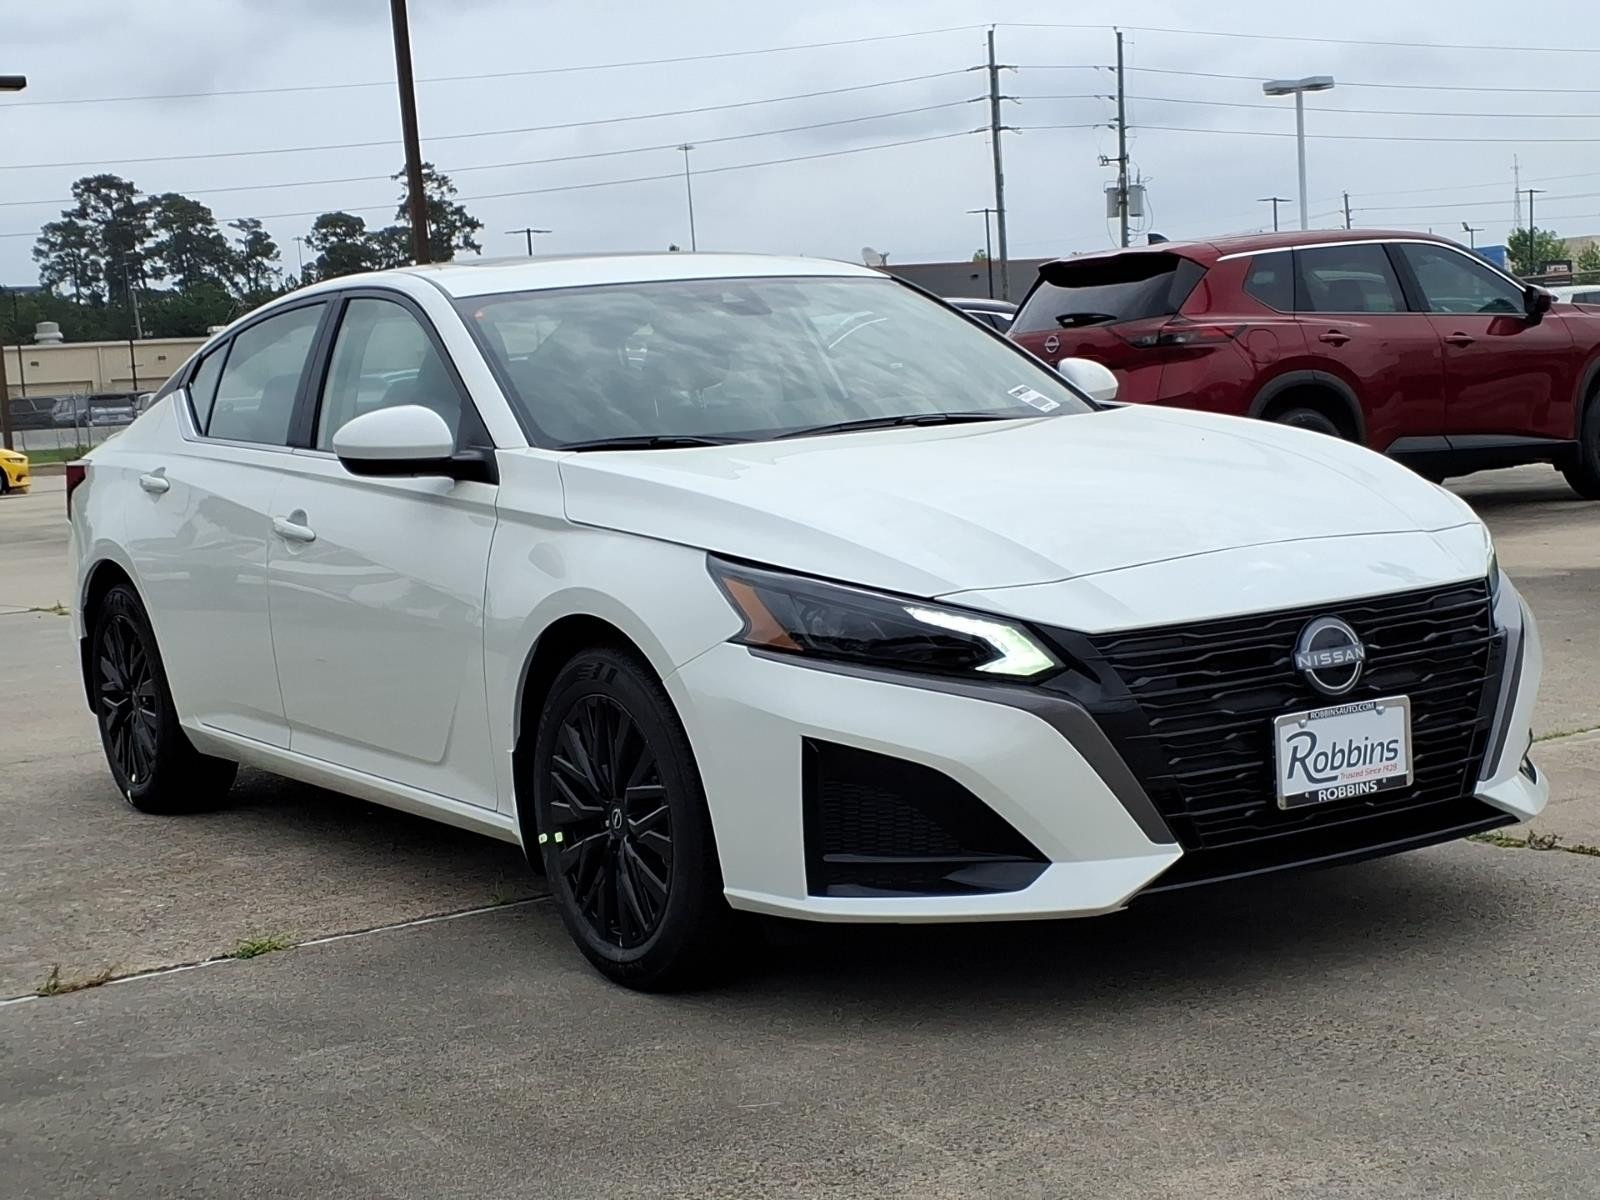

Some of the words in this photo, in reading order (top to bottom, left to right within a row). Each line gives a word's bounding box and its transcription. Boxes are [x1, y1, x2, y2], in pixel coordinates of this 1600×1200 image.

[1298, 646, 1364, 667] NISSAN
[1310, 702, 1375, 719] ROBBINSAUTO.COM
[1286, 731, 1399, 784] Robbins
[1340, 771, 1364, 780] Trusted
[1365, 767, 1382, 776] Since
[1318, 781, 1378, 802] ROBBINS
